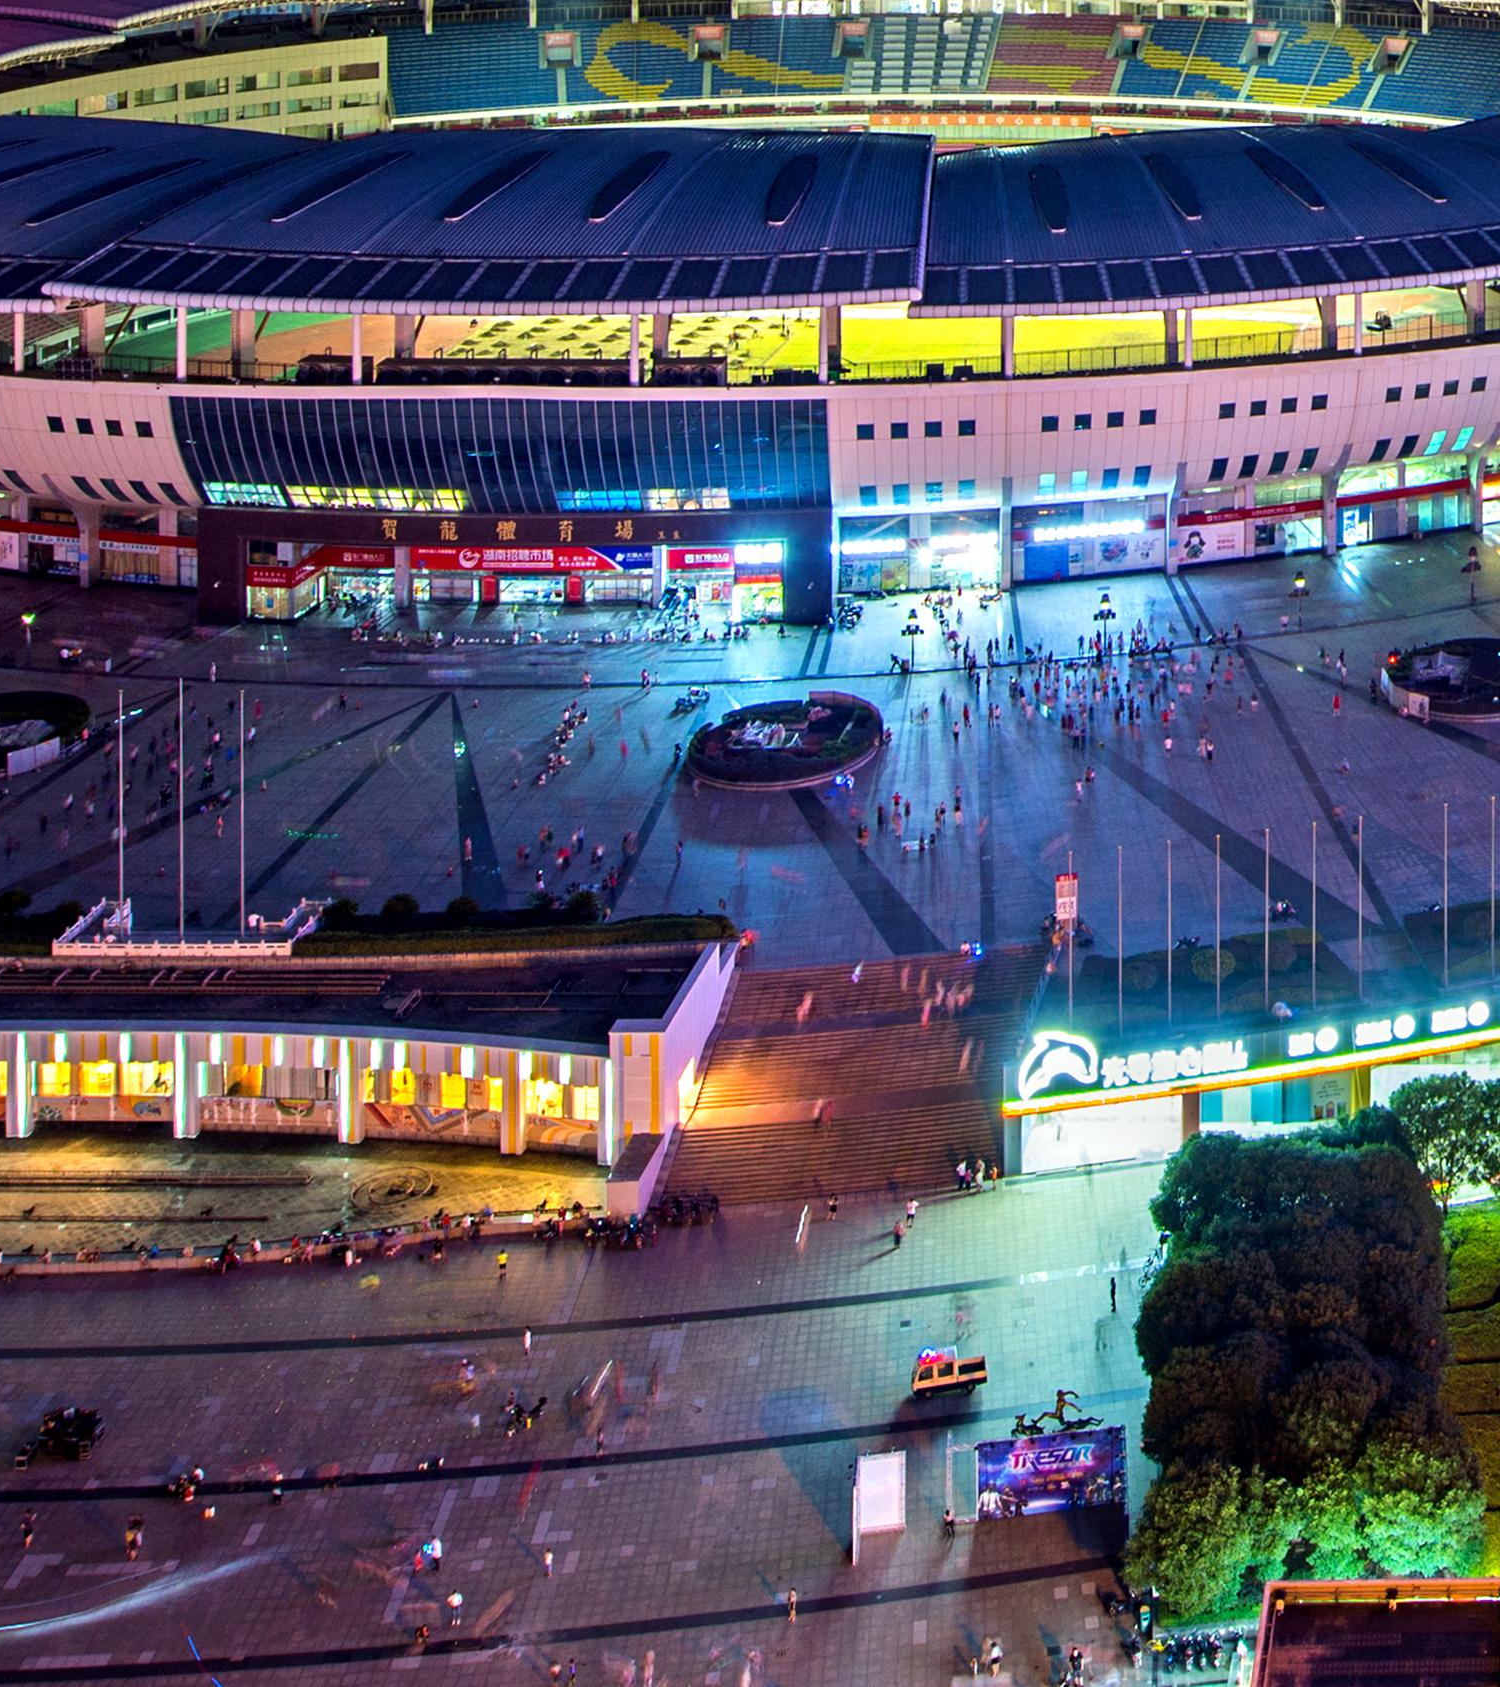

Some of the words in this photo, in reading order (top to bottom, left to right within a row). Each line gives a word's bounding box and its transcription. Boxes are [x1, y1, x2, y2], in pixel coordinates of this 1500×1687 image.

[482, 548, 554, 562] 湖南招聘市场
